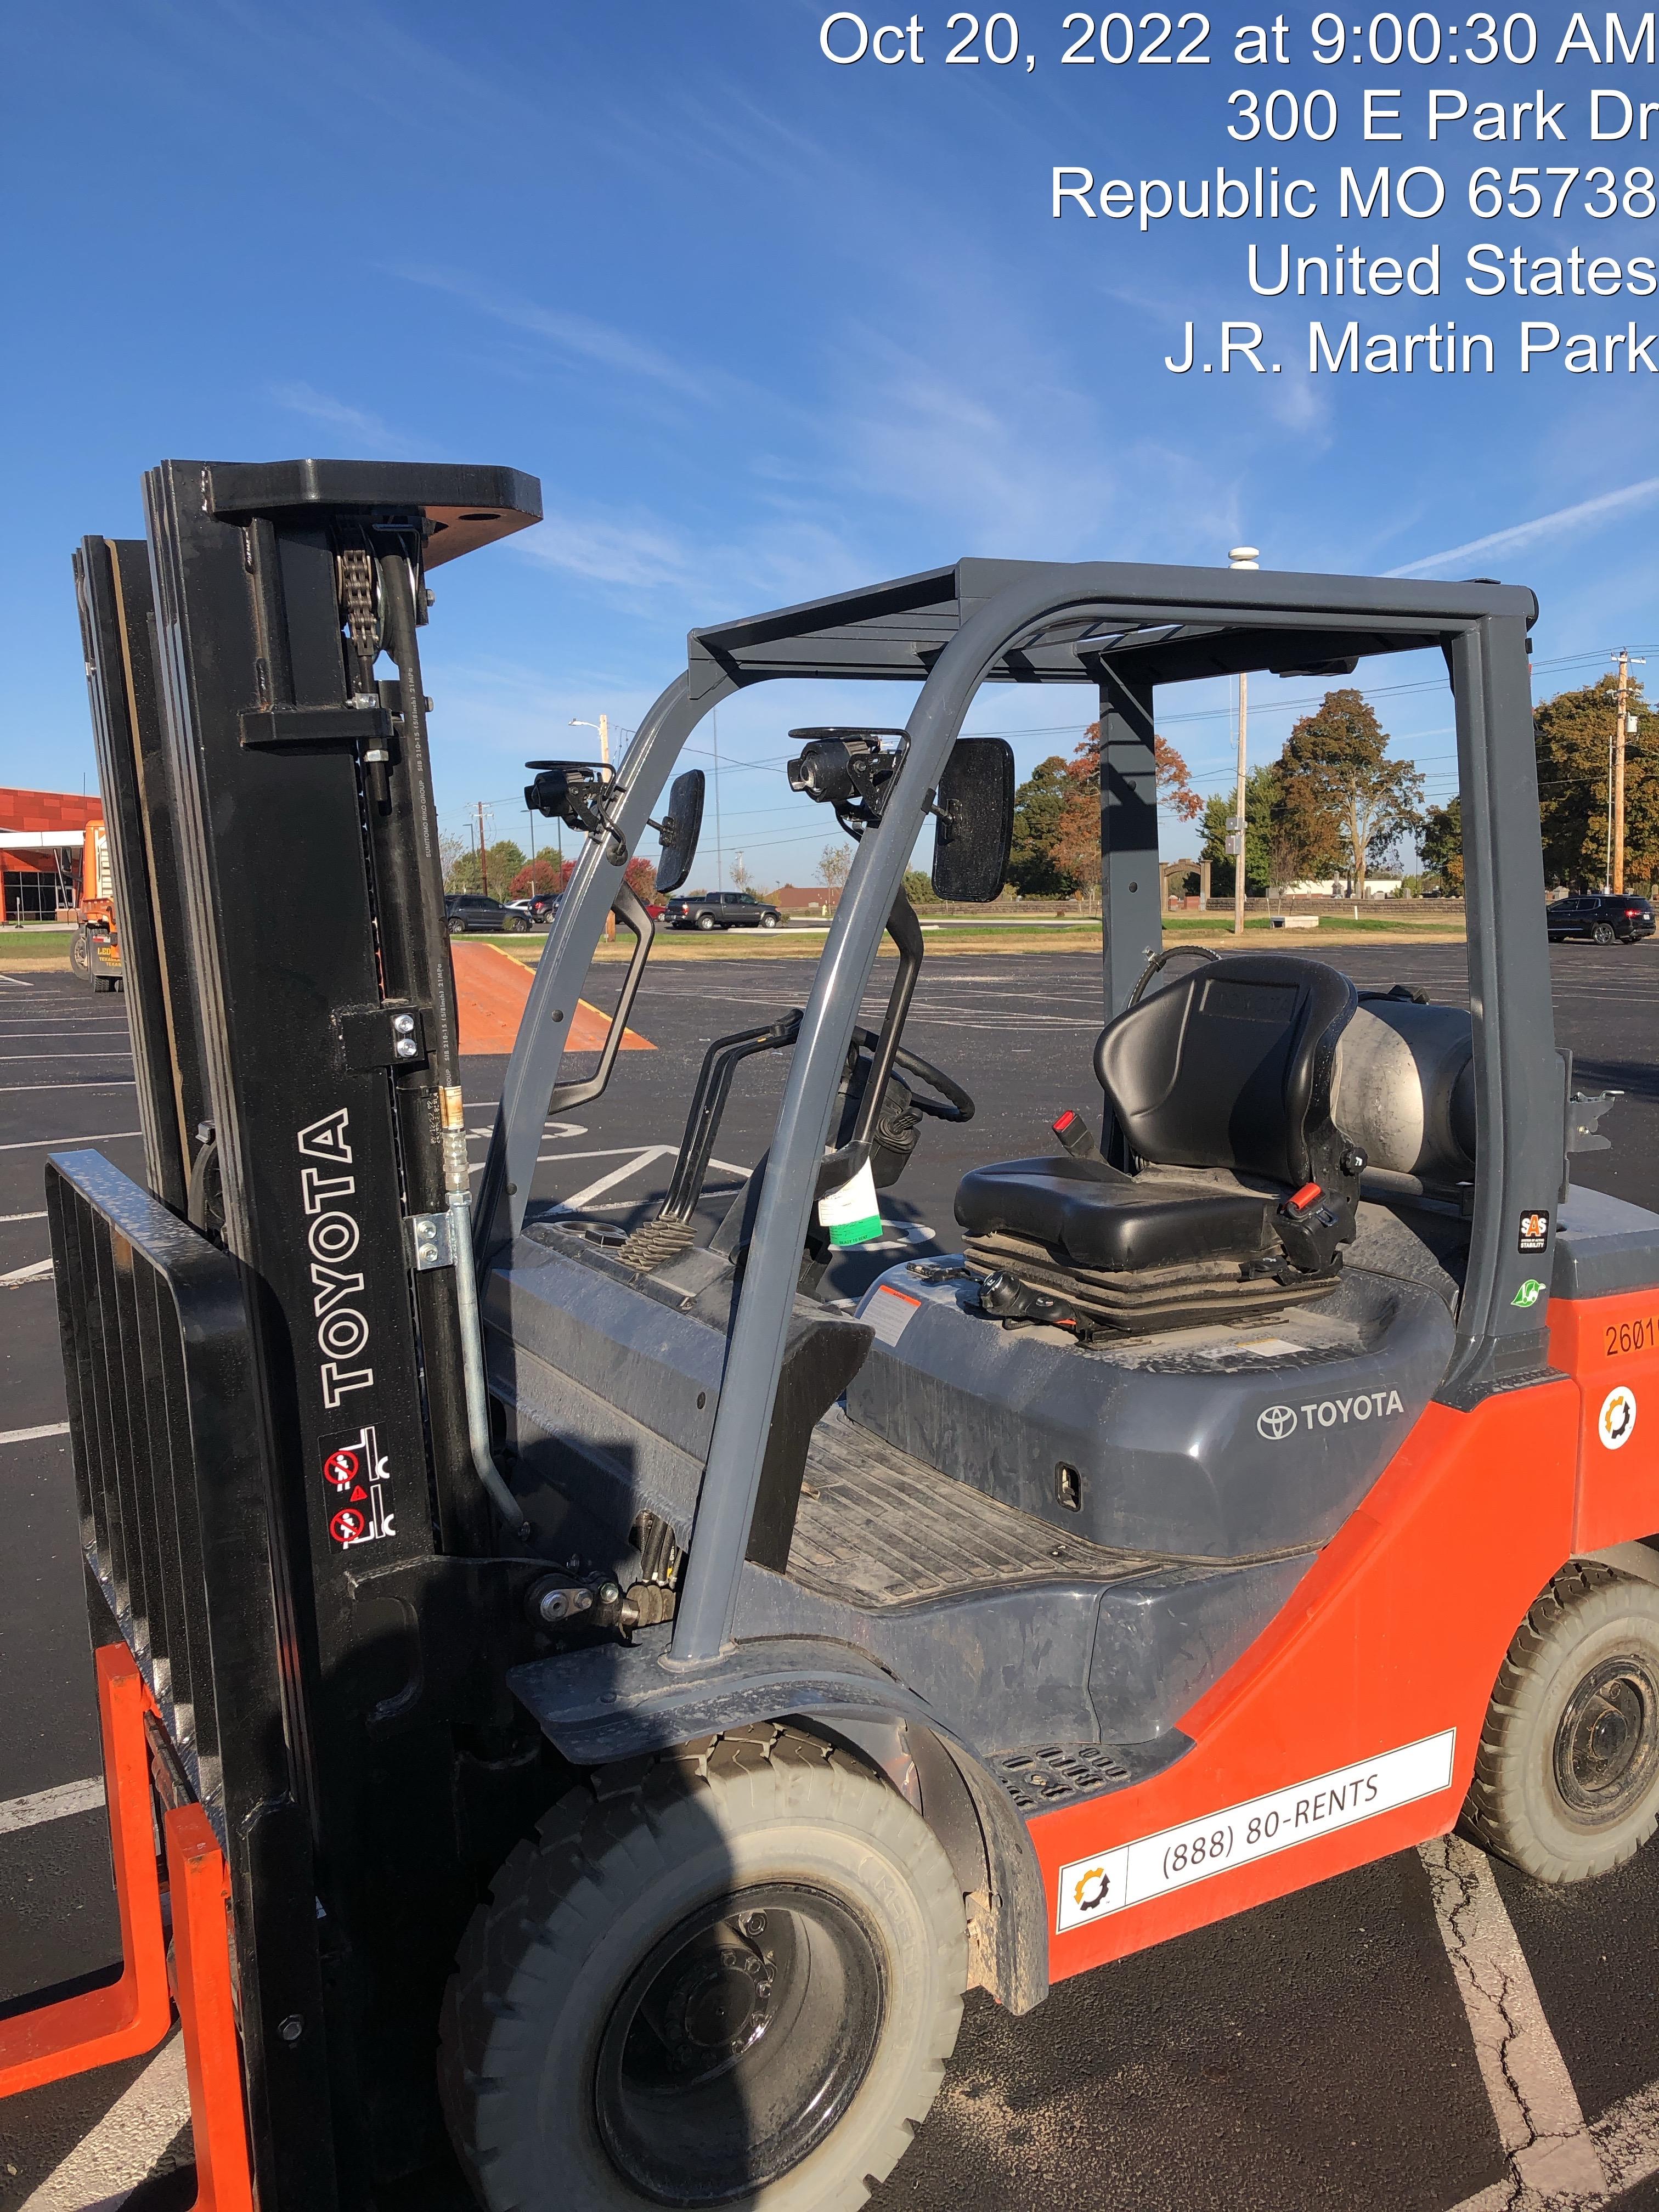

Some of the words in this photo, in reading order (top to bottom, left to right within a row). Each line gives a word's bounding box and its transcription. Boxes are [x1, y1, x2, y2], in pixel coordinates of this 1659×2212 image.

[414, 732, 422, 758] 210-15
[422, 822, 431, 857] SUMITOMO
[1521, 1214, 1547, 1237] SAS
[297, 1107, 374, 1409] TOYOTA
[1606, 1317, 1659, 1356] 2601
[1301, 1390, 1404, 1430] TOYOTA
[1163, 1825, 1234, 1880] (888)
[1246, 1773, 1378, 1844] 80-RENTS
